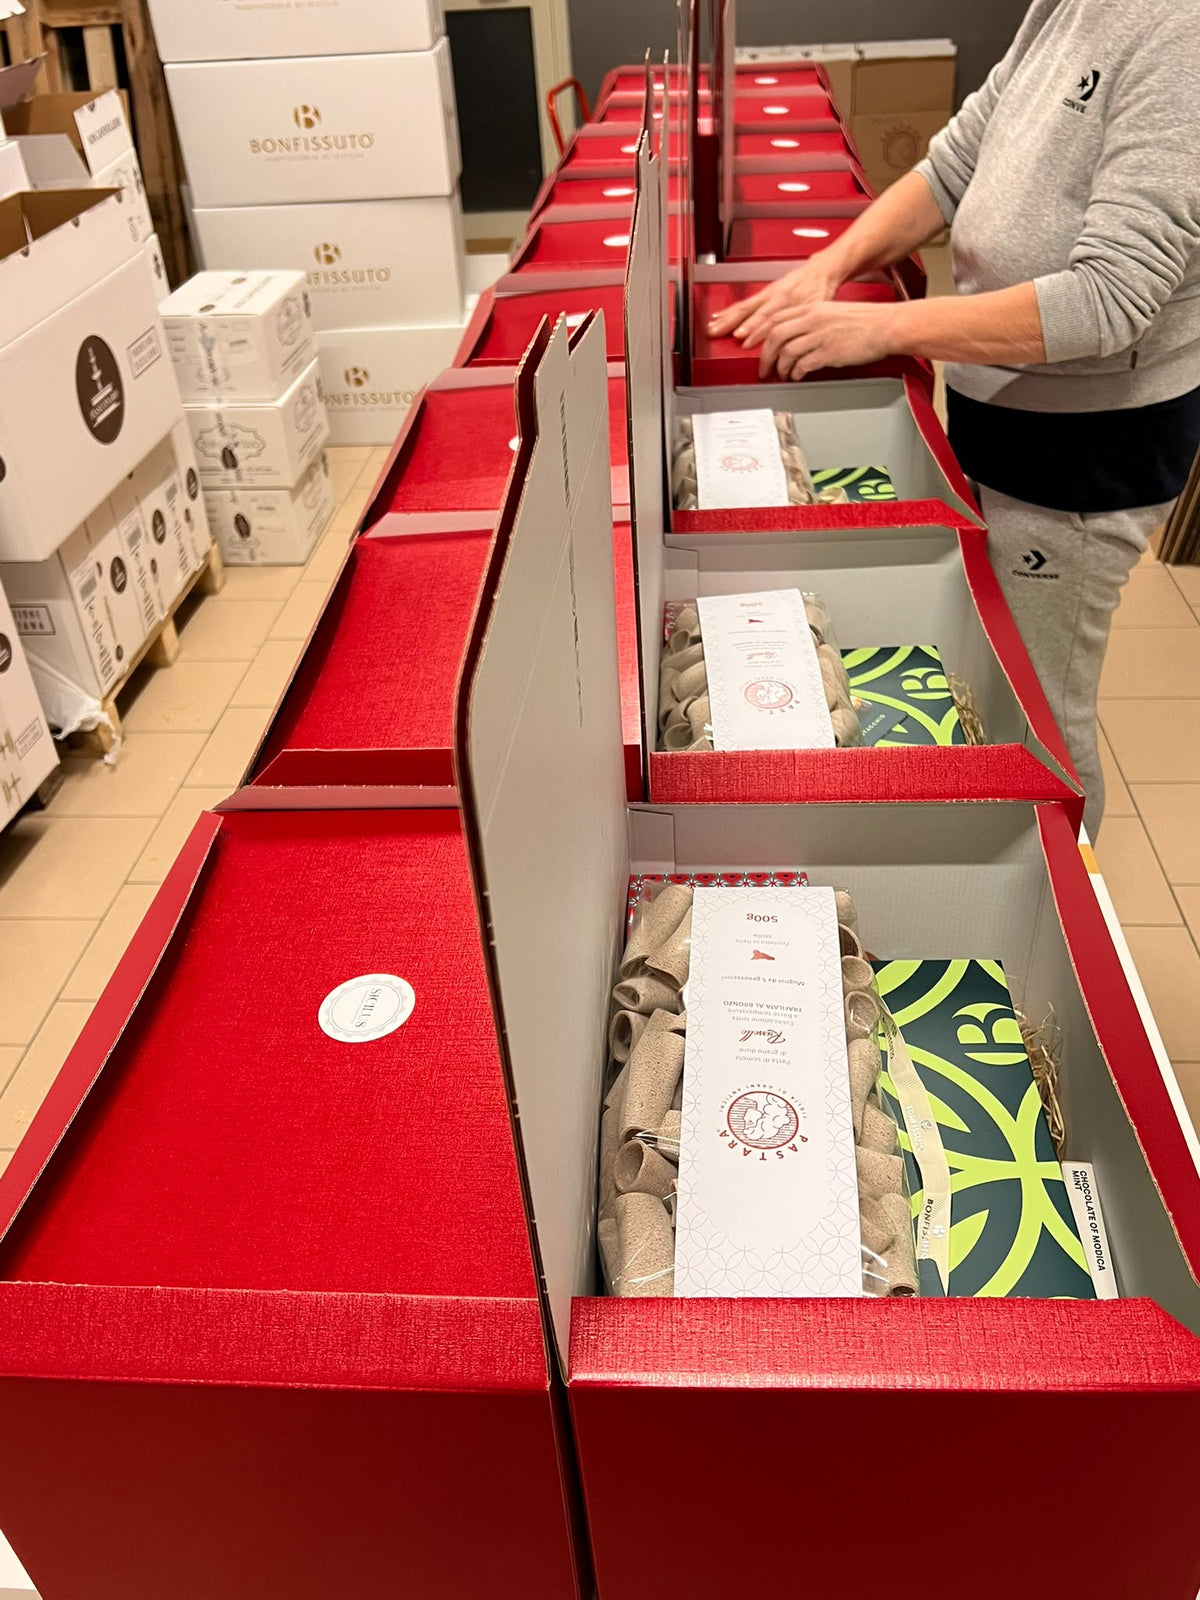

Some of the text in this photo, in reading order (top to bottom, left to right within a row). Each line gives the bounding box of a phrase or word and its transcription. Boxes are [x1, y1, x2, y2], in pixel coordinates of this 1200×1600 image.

[249, 134, 375, 154] BONFISSUTO
[746, 913, 778, 923] 500g
[765, 1004, 802, 1012] TRAFILATA
[732, 1015, 750, 1023] lenta
[735, 1055, 761, 1063] semola
[771, 1058, 791, 1066] Pasta
[719, 1130, 809, 1161] PASTARA
[1072, 1170, 1083, 1191] MINT
[1080, 1170, 1106, 1271] CHOCOLATE OF MODICA
